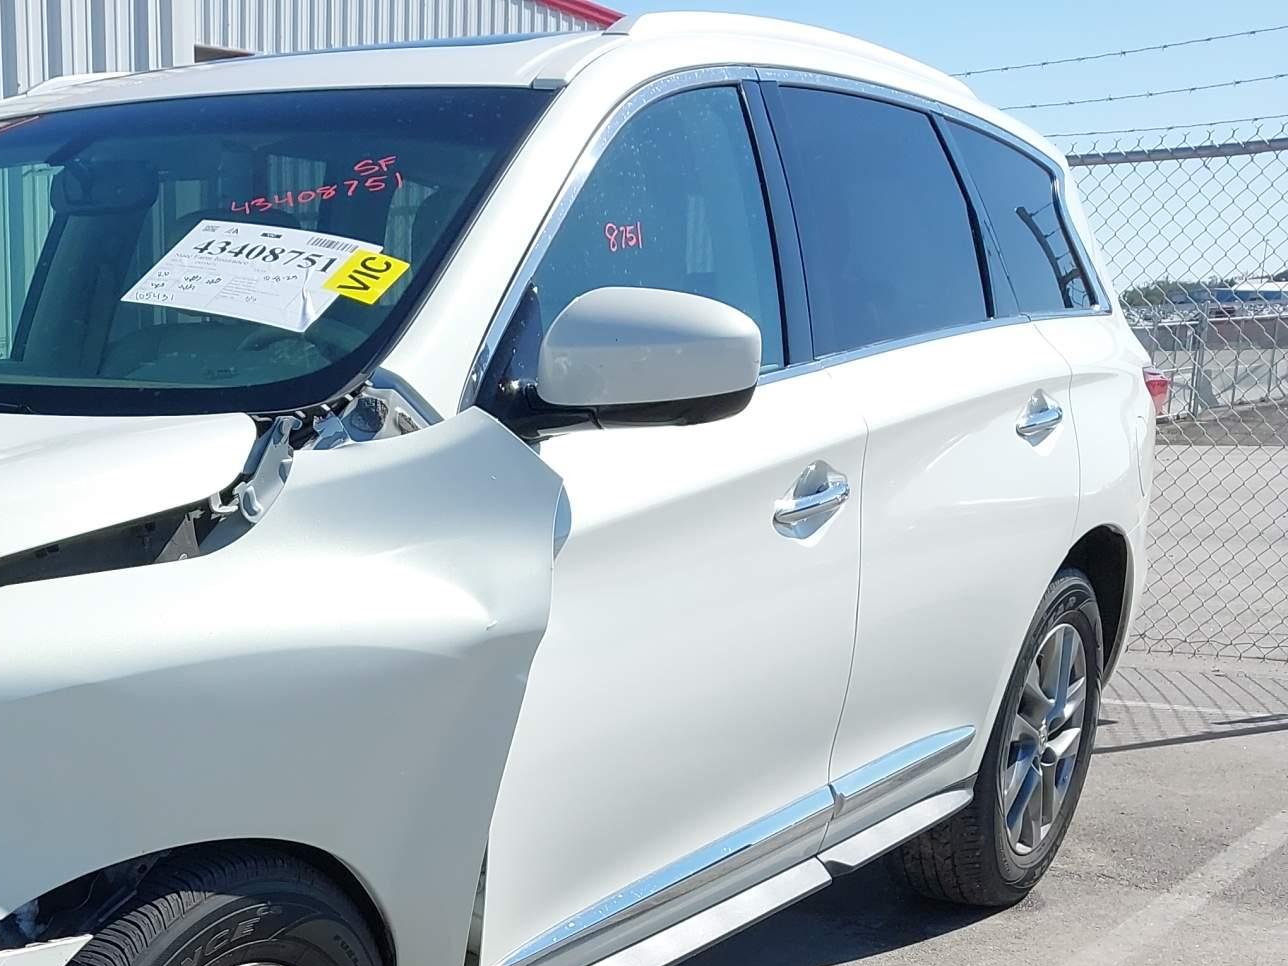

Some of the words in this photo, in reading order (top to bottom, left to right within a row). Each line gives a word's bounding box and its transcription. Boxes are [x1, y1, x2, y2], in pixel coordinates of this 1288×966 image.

[354, 155, 397, 176] SF
[231, 172, 404, 215] 43408751
[605, 221, 643, 252] 8751
[193, 239, 337, 273] 43408751
[337, 256, 392, 293] VIC
